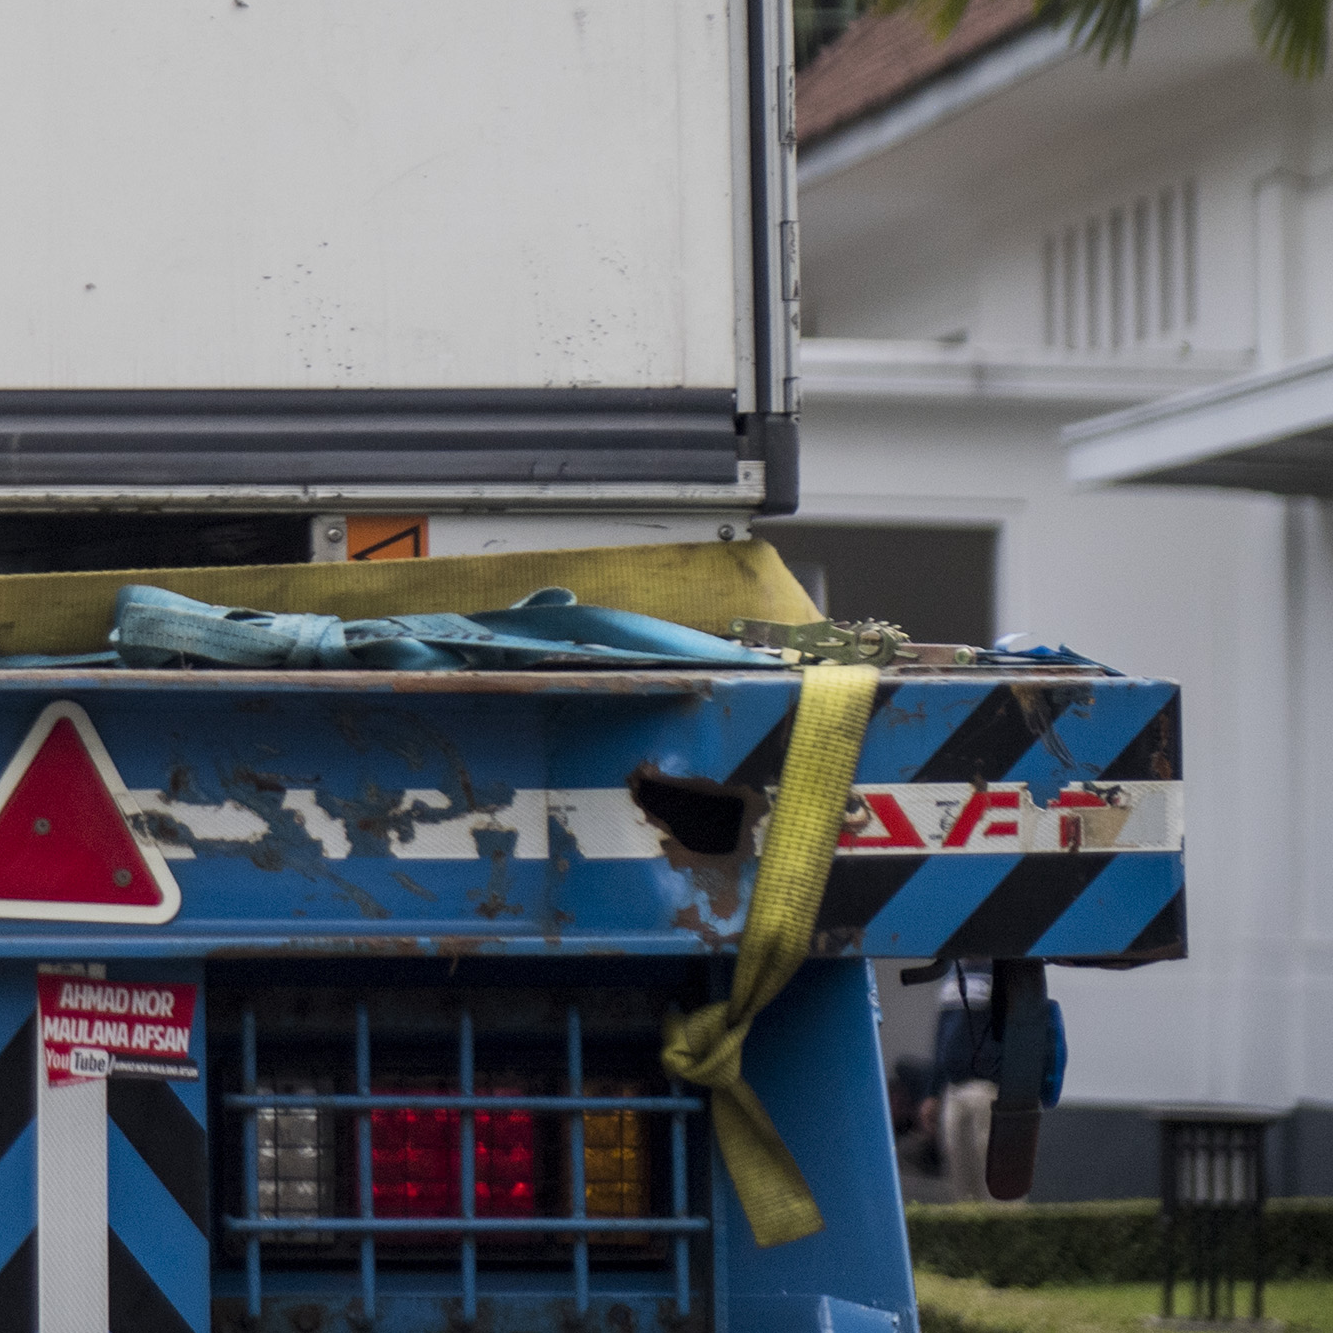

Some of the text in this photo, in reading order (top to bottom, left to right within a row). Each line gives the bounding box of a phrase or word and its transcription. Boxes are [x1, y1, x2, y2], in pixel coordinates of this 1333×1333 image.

[59, 983, 175, 1017] AHMAD NOR
[44, 1015, 190, 1053] MAULANA AFSAN
